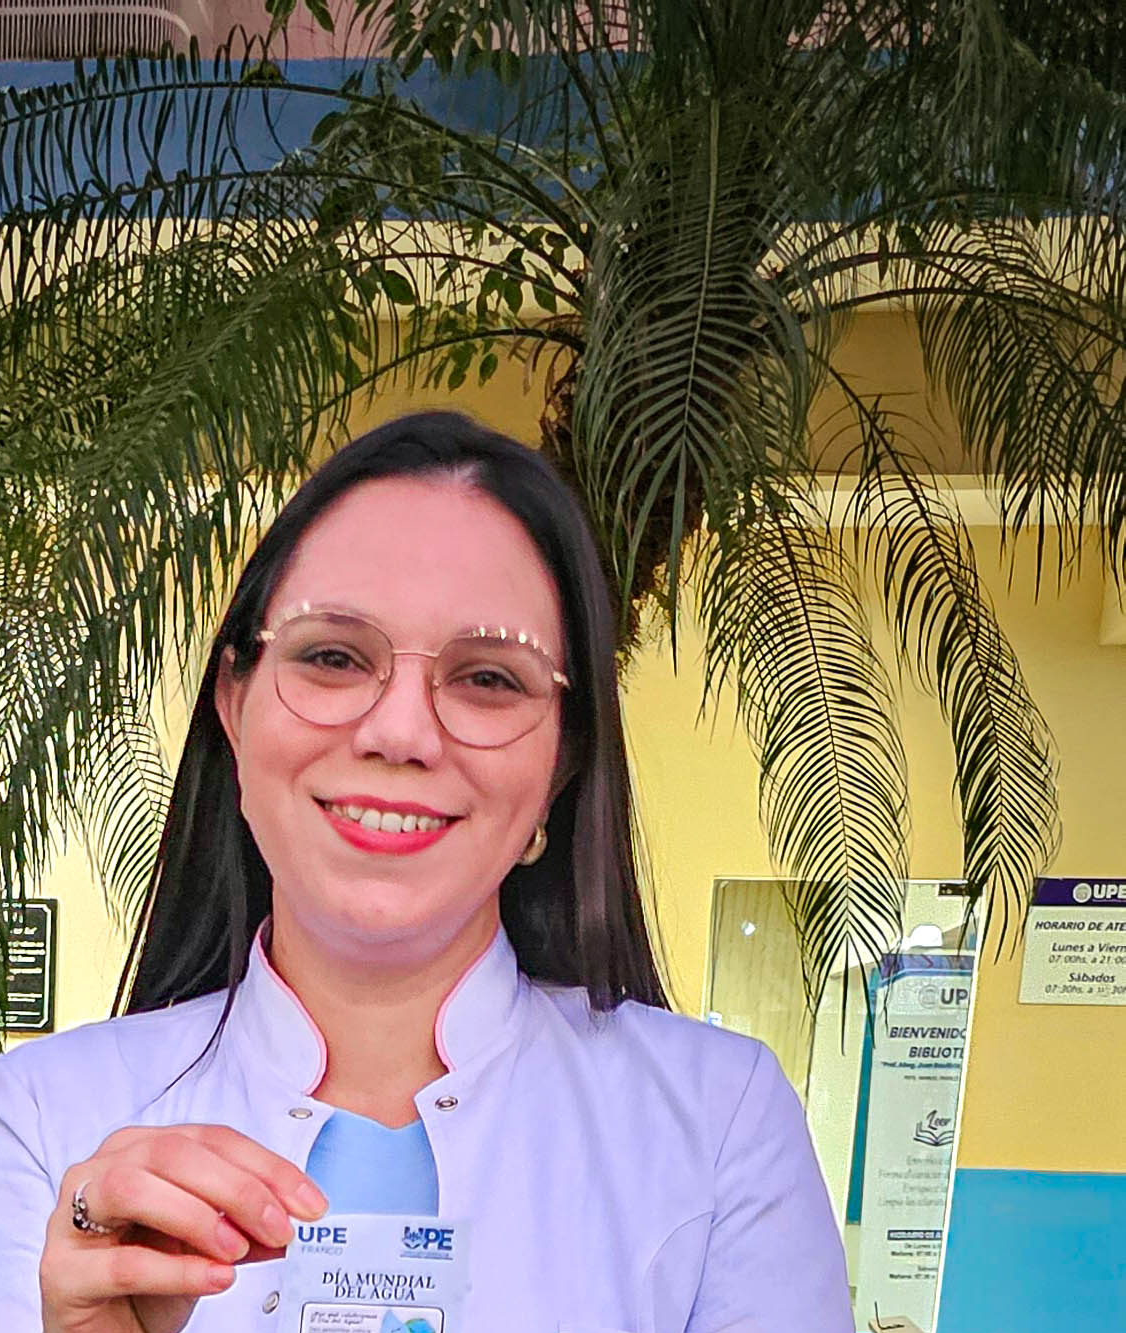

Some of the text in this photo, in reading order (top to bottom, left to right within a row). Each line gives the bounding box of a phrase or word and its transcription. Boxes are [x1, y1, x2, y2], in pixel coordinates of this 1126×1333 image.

[1093, 884, 1126, 899] UPE
[1035, 921, 1085, 930] HORARIO
[1088, 922, 1102, 931] DE
[1052, 942, 1084, 952] Lunes
[298, 1226, 348, 1244] UPE
[322, 1268, 436, 1290] DÍA MUNDIAL
[335, 1285, 416, 1300] DEL AGUA
